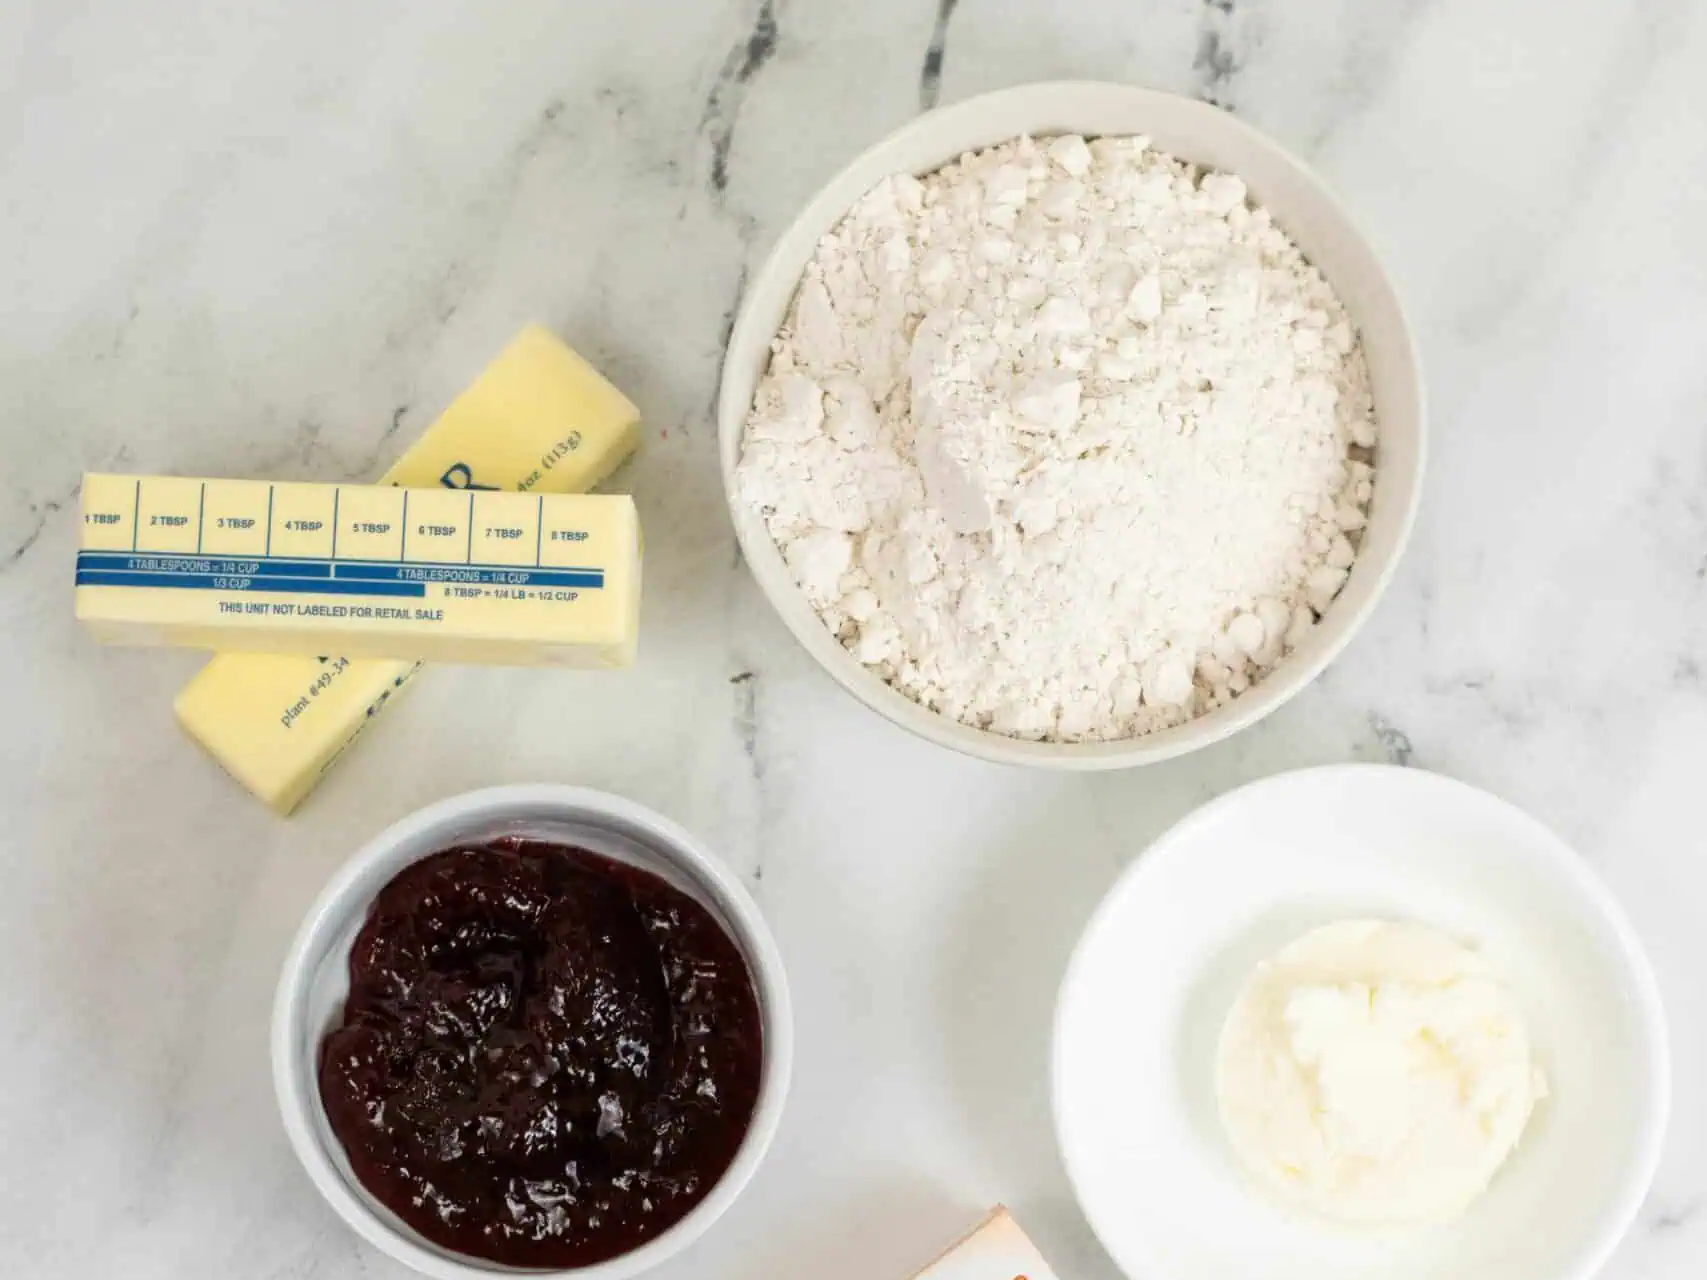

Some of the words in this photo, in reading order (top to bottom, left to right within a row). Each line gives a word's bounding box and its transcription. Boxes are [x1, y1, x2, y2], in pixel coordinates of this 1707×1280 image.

[93, 514, 121, 524] TBSP
[159, 516, 189, 527] TBSP
[226, 518, 255, 529] TBSP
[294, 521, 323, 532] TBSP
[361, 523, 390, 534] TBSP
[426, 526, 456, 537] TBSP
[494, 528, 524, 540] TBSP
[559, 531, 589, 542] TBSP
[135, 560, 210, 573] TABLESPOONS
[222, 562, 235, 573] 1/4
[238, 563, 259, 574] CUP
[403, 569, 480, 582] TABLESPOONS
[491, 572, 506, 584] 1/4
[508, 573, 530, 585] CUP
[229, 578, 251, 589] CUP
[453, 588, 482, 599] TBSP
[494, 589, 509, 600] 1/4
[511, 589, 525, 600] LB
[539, 591, 553, 602] 1/2
[555, 591, 579, 602] CUP
[219, 601, 243, 613] THIS
[246, 602, 269, 615] UNIT
[272, 603, 295, 616] NOT
[297, 604, 347, 618] LABELED
[350, 605, 373, 618] FOR
[375, 607, 412, 620] RETAIL
[415, 609, 444, 621] SALE
